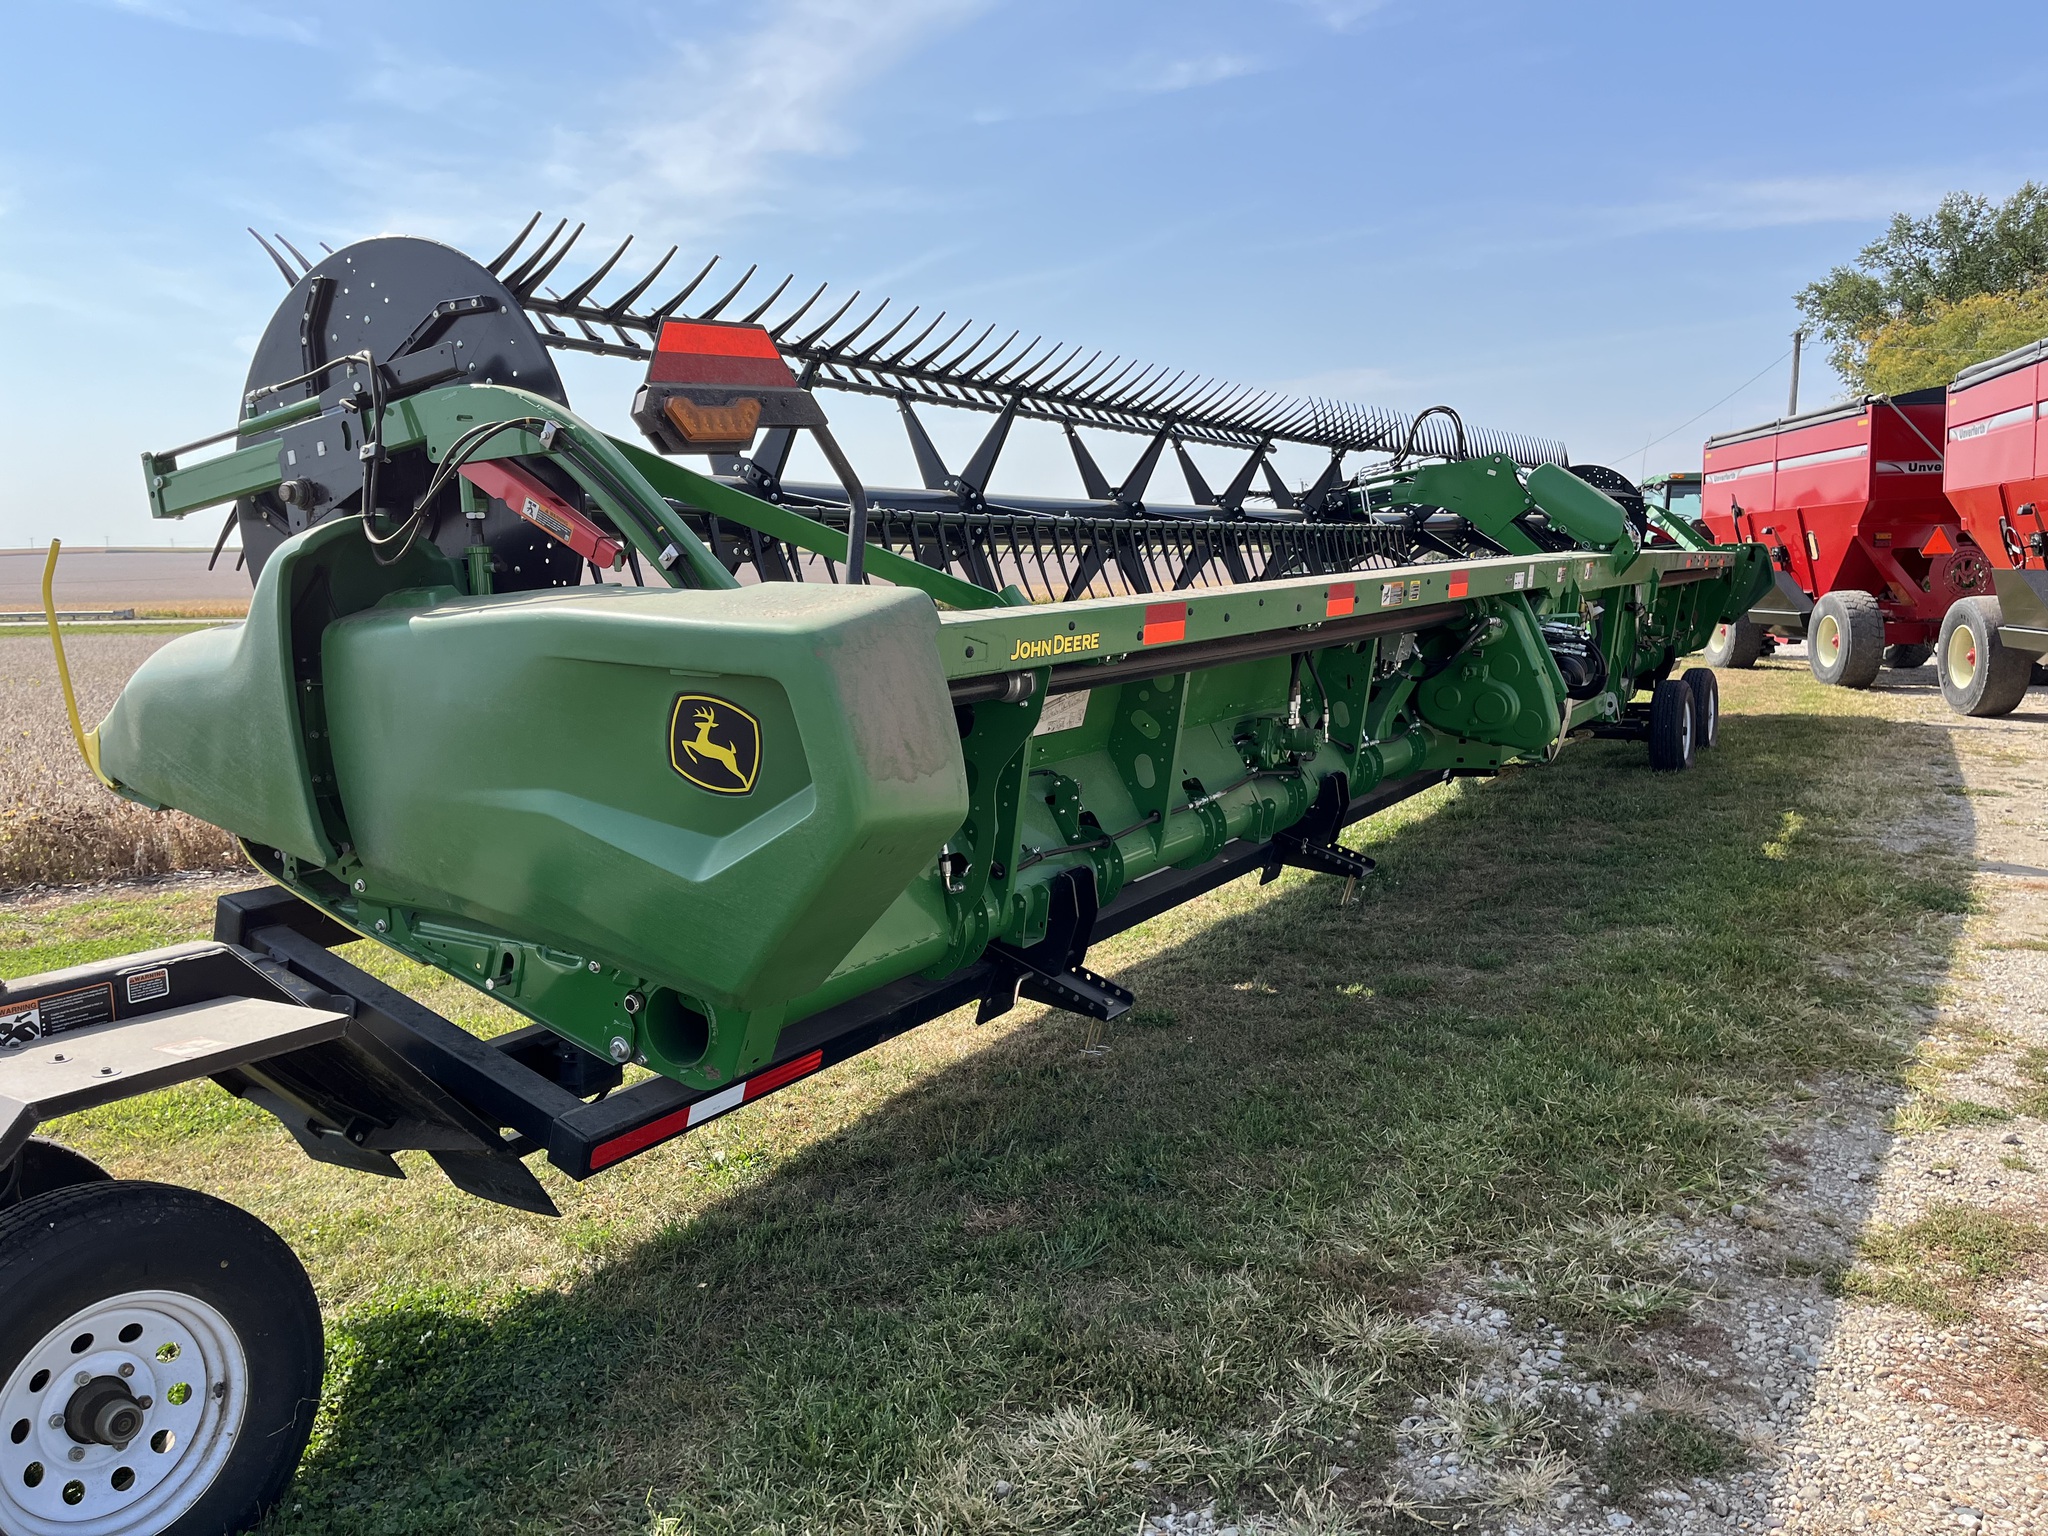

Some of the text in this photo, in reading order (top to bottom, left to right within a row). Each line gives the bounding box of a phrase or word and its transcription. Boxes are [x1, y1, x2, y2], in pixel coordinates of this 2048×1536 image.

[1908, 463, 1944, 472] Unve
[1010, 632, 1100, 661] JOHN DEERE
[134, 971, 166, 982] WARNING
[0, 1002, 37, 1015] WARNING
